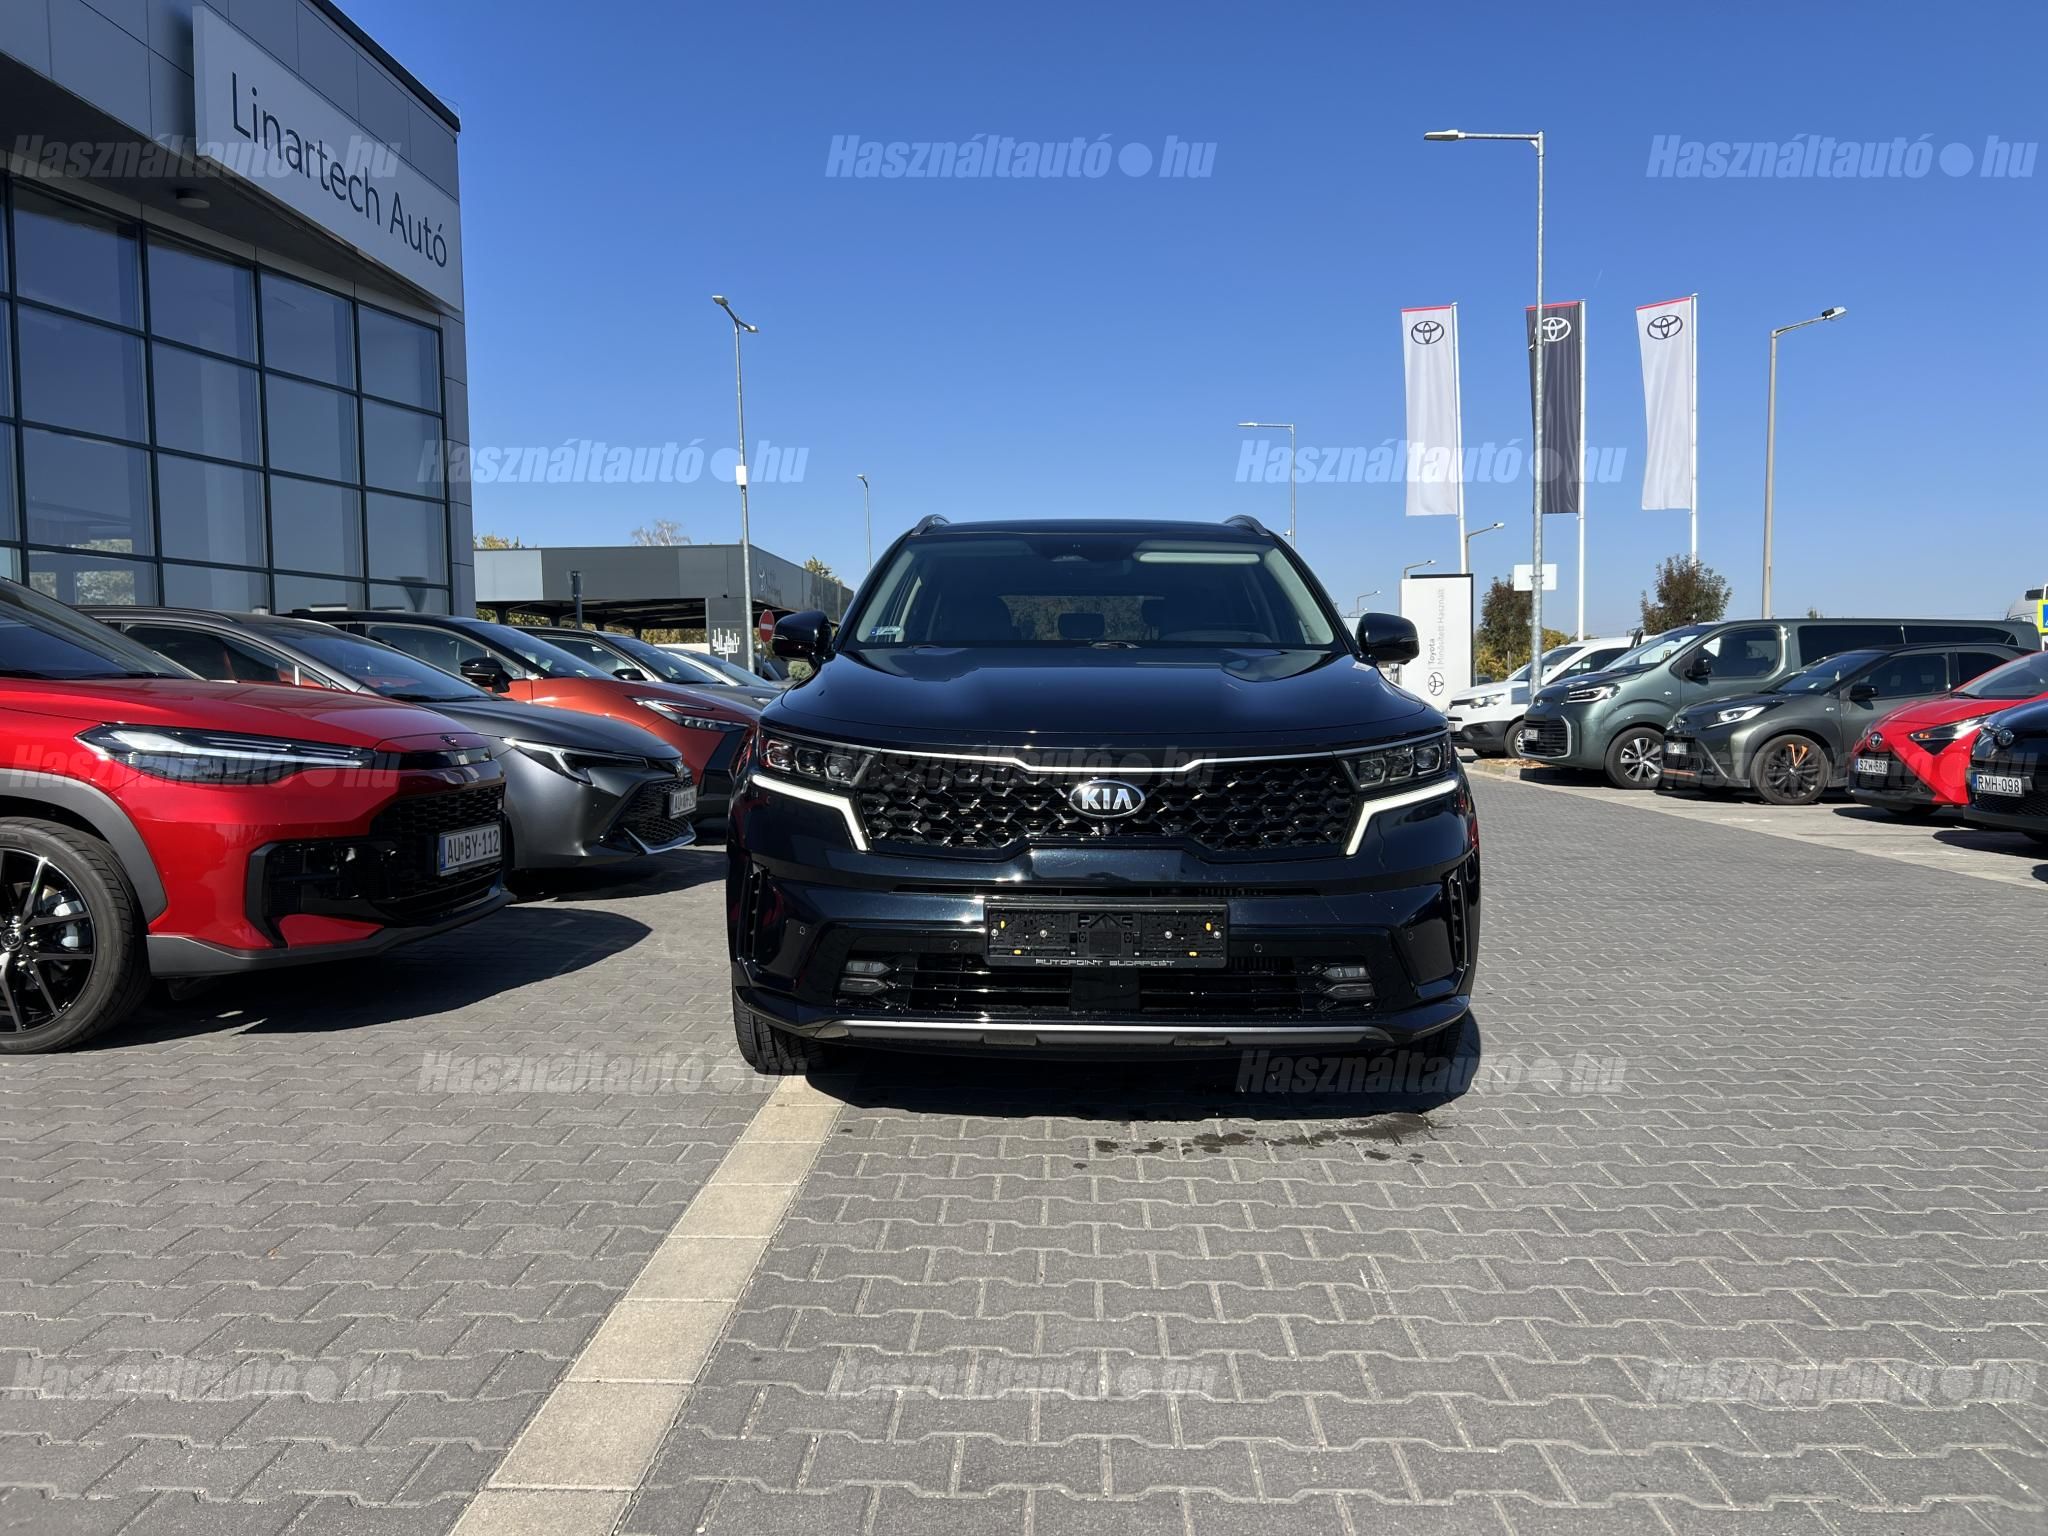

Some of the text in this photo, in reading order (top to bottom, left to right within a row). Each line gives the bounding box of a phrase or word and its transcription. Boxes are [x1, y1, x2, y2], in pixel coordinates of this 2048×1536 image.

[232, 72, 447, 267] Linartech Autó
[1428, 638, 1436, 665] Toyota
[1978, 776, 2019, 793] RMH-098
[1081, 788, 1133, 809] KIA
